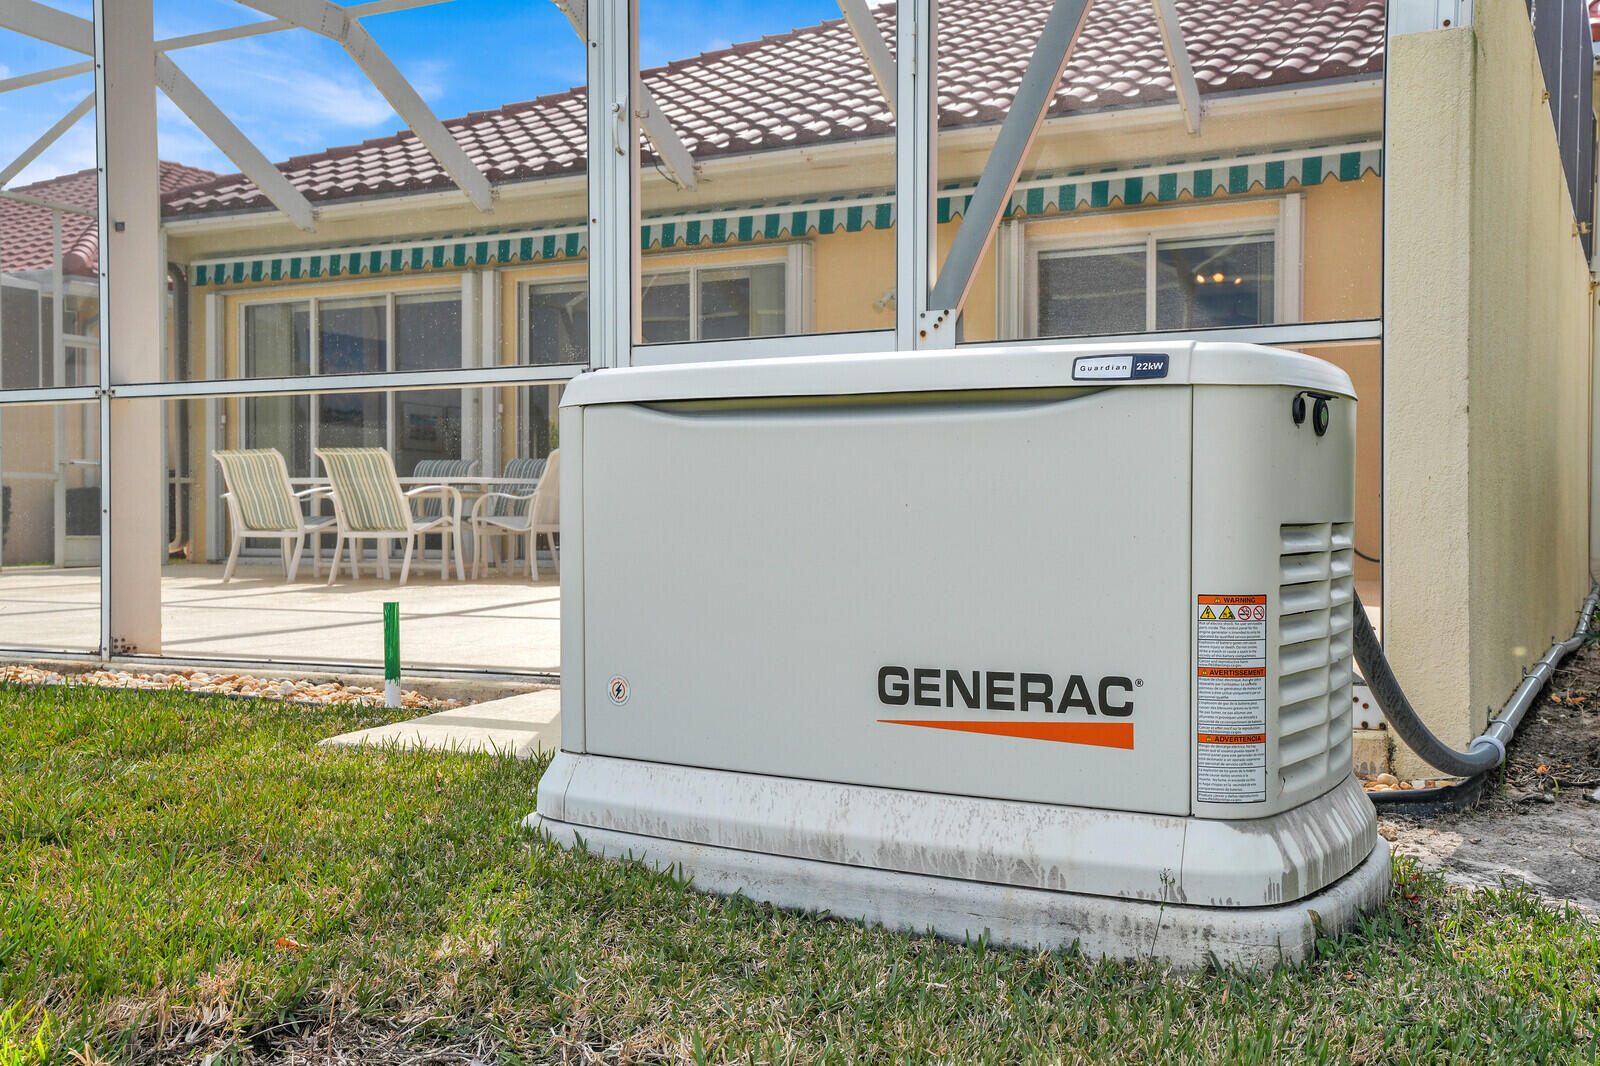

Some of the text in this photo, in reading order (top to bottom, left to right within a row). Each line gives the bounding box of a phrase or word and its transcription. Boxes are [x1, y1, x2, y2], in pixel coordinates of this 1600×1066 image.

[1079, 362, 1164, 372] Guardian 22kW
[1214, 735, 1262, 743] ADVERTENCIA
